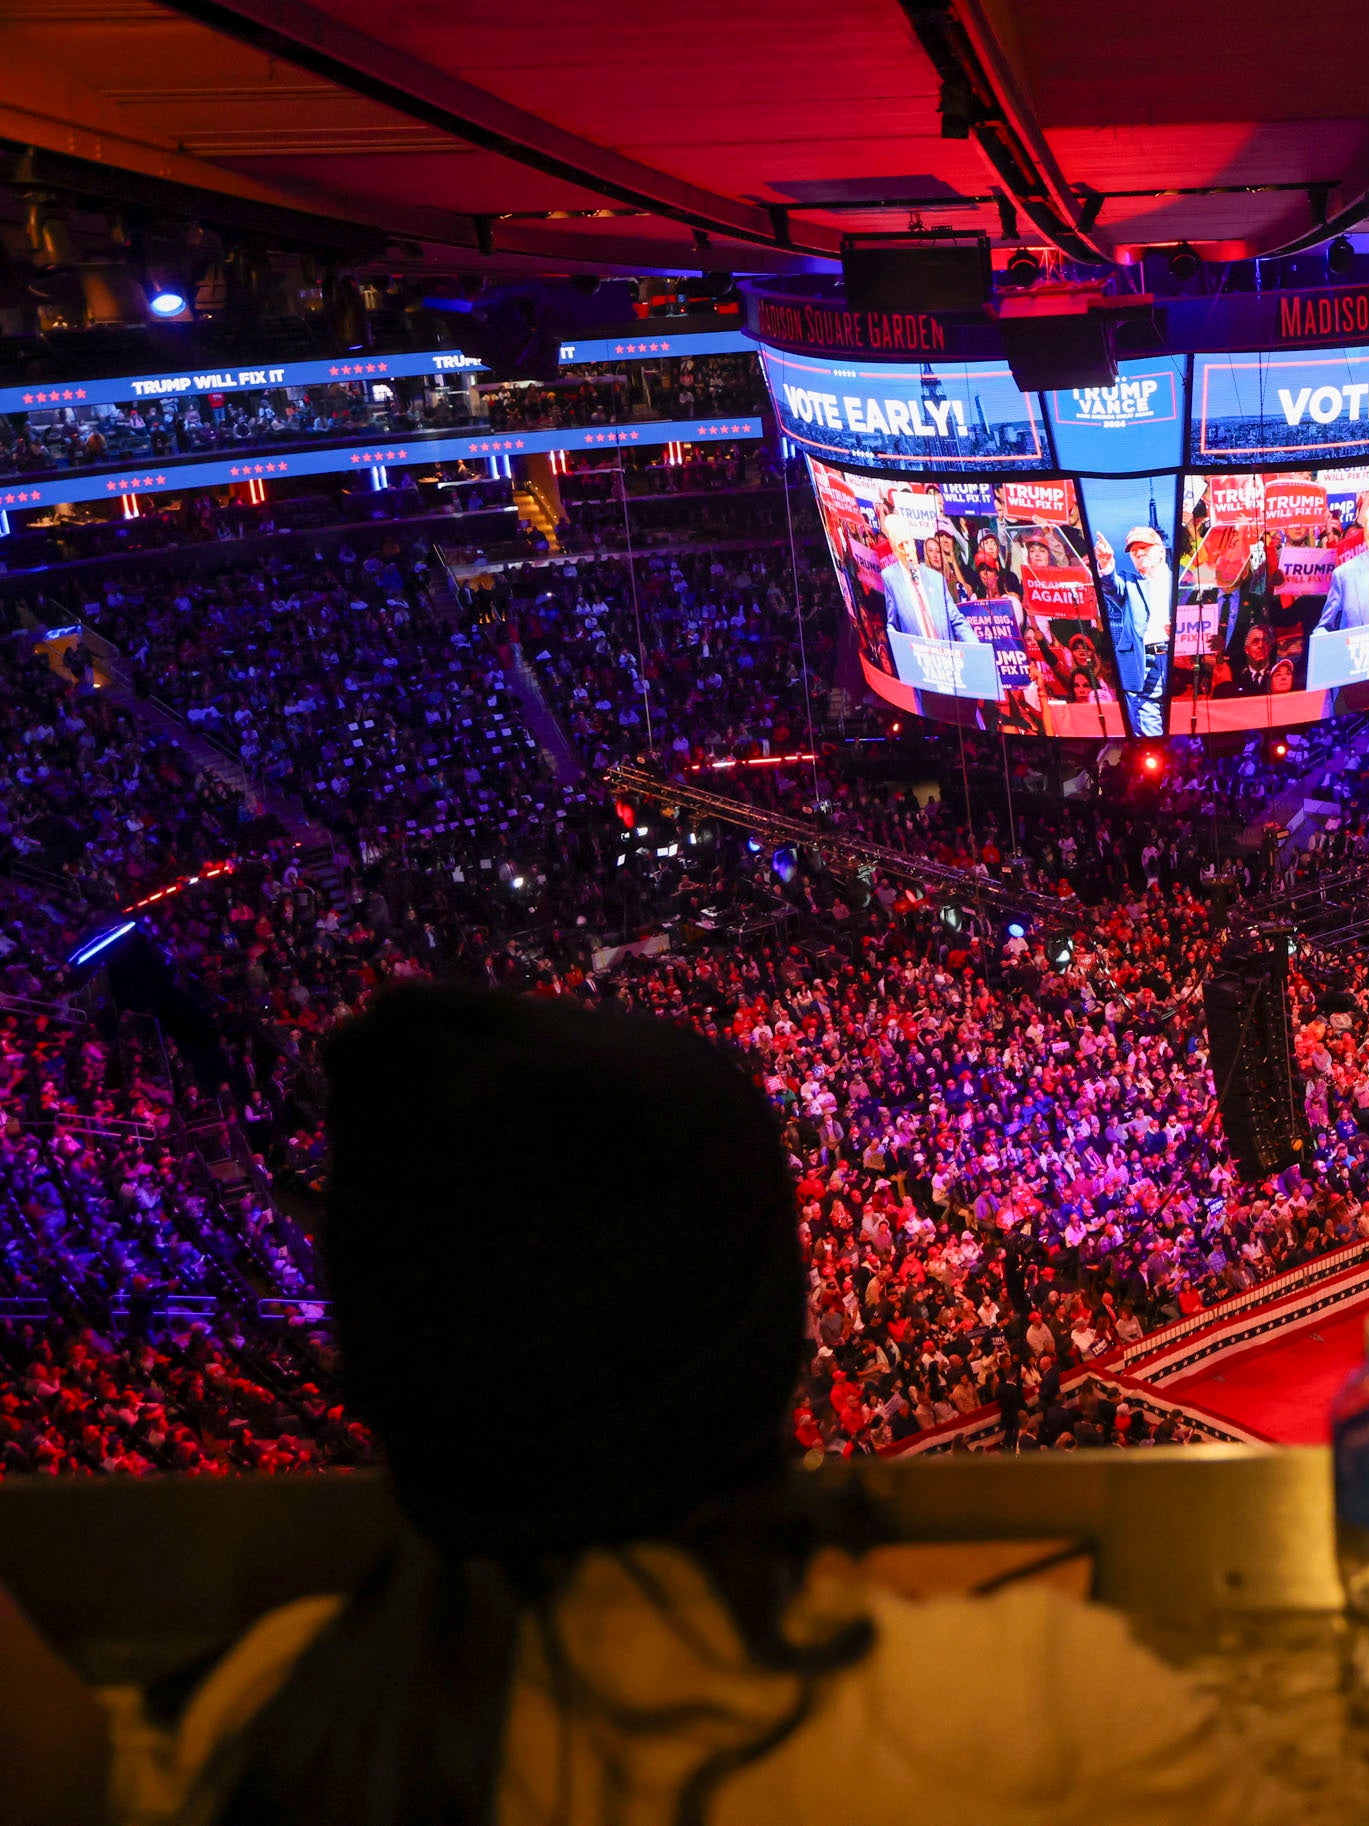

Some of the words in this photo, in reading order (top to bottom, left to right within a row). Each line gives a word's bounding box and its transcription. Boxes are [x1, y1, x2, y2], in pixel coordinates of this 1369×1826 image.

[760, 299, 802, 340] MADISON
[805, 305, 864, 347] SQUARE
[867, 312, 945, 350] GARDEN
[560, 346, 575, 360] IT
[132, 377, 191, 396] TRUMP
[194, 373, 236, 389] WILL
[238, 371, 266, 386] FIX
[269, 369, 284, 383] IT
[783, 383, 843, 428] VOTE
[852, 394, 968, 437] EARLY!
[1078, 397, 1149, 414] VANCE
[1323, 472, 1345, 481] WILL
[1347, 472, 1361, 480] FIX
[1362, 471, 1369, 479] IT
[943, 483, 990, 496] TRUMP
[1006, 484, 1064, 502] TRUMP
[1214, 486, 1263, 503] TRUM
[944, 494, 962, 503] WILL
[966, 494, 980, 503] FIX
[982, 494, 992, 503] IT
[1008, 497, 1033, 508] WILL
[1036, 500, 1051, 510] FIX
[1053, 502, 1064, 511] IT
[1266, 495, 1324, 510] TRUMP
[899, 507, 937, 521] TRUMP
[1216, 502, 1242, 512] WILL
[1266, 509, 1292, 519] WILL
[1295, 507, 1311, 516] FIX
[1313, 507, 1323, 516] IT
[1338, 543, 1368, 562] TRUM
[854, 553, 881, 573] TRUMP
[1284, 563, 1335, 575] TRUMP
[1031, 590, 1084, 605] AGAIN!
[968, 615, 991, 625] REAM
[994, 615, 1013, 626] BIG,
[1176, 621, 1211, 634] UMP
[974, 625, 1012, 637] GAIN!
[1181, 634, 1197, 643] FIX
[995, 651, 1027, 665] UMP
[1001, 665, 1018, 675] FIX
[1020, 665, 1030, 675] IT
